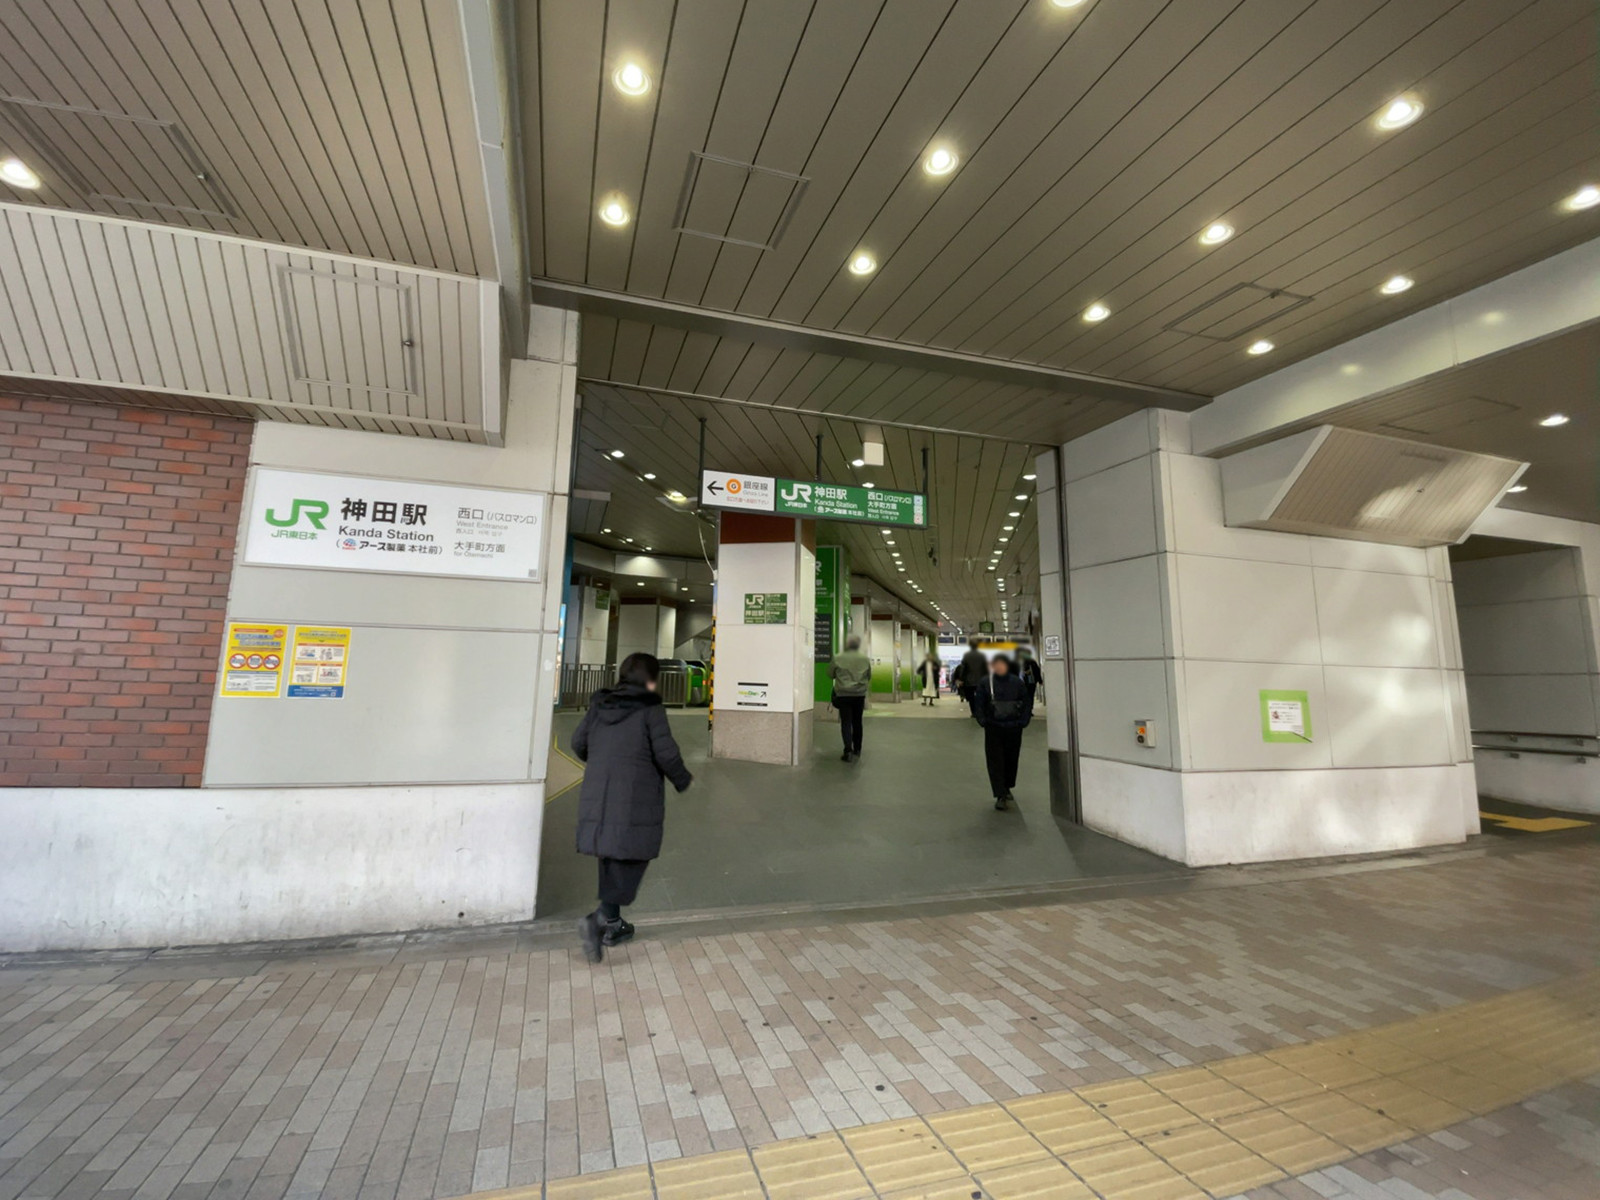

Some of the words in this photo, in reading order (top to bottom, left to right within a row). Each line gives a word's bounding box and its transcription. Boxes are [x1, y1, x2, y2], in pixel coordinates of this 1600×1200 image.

[781, 483, 812, 503] JR
[814, 486, 847, 500] 神田駅
[867, 491, 884, 501] 西口
[814, 498, 835, 507] Kanda
[835, 500, 858, 509] Station
[265, 498, 330, 530] JR
[340, 497, 428, 526] 神田駅
[457, 507, 484, 521] 西口
[271, 529, 318, 541] JR東日本
[338, 525, 383, 539] Kanda
[386, 528, 434, 543] Station
[454, 541, 506, 553] 大手町方面
